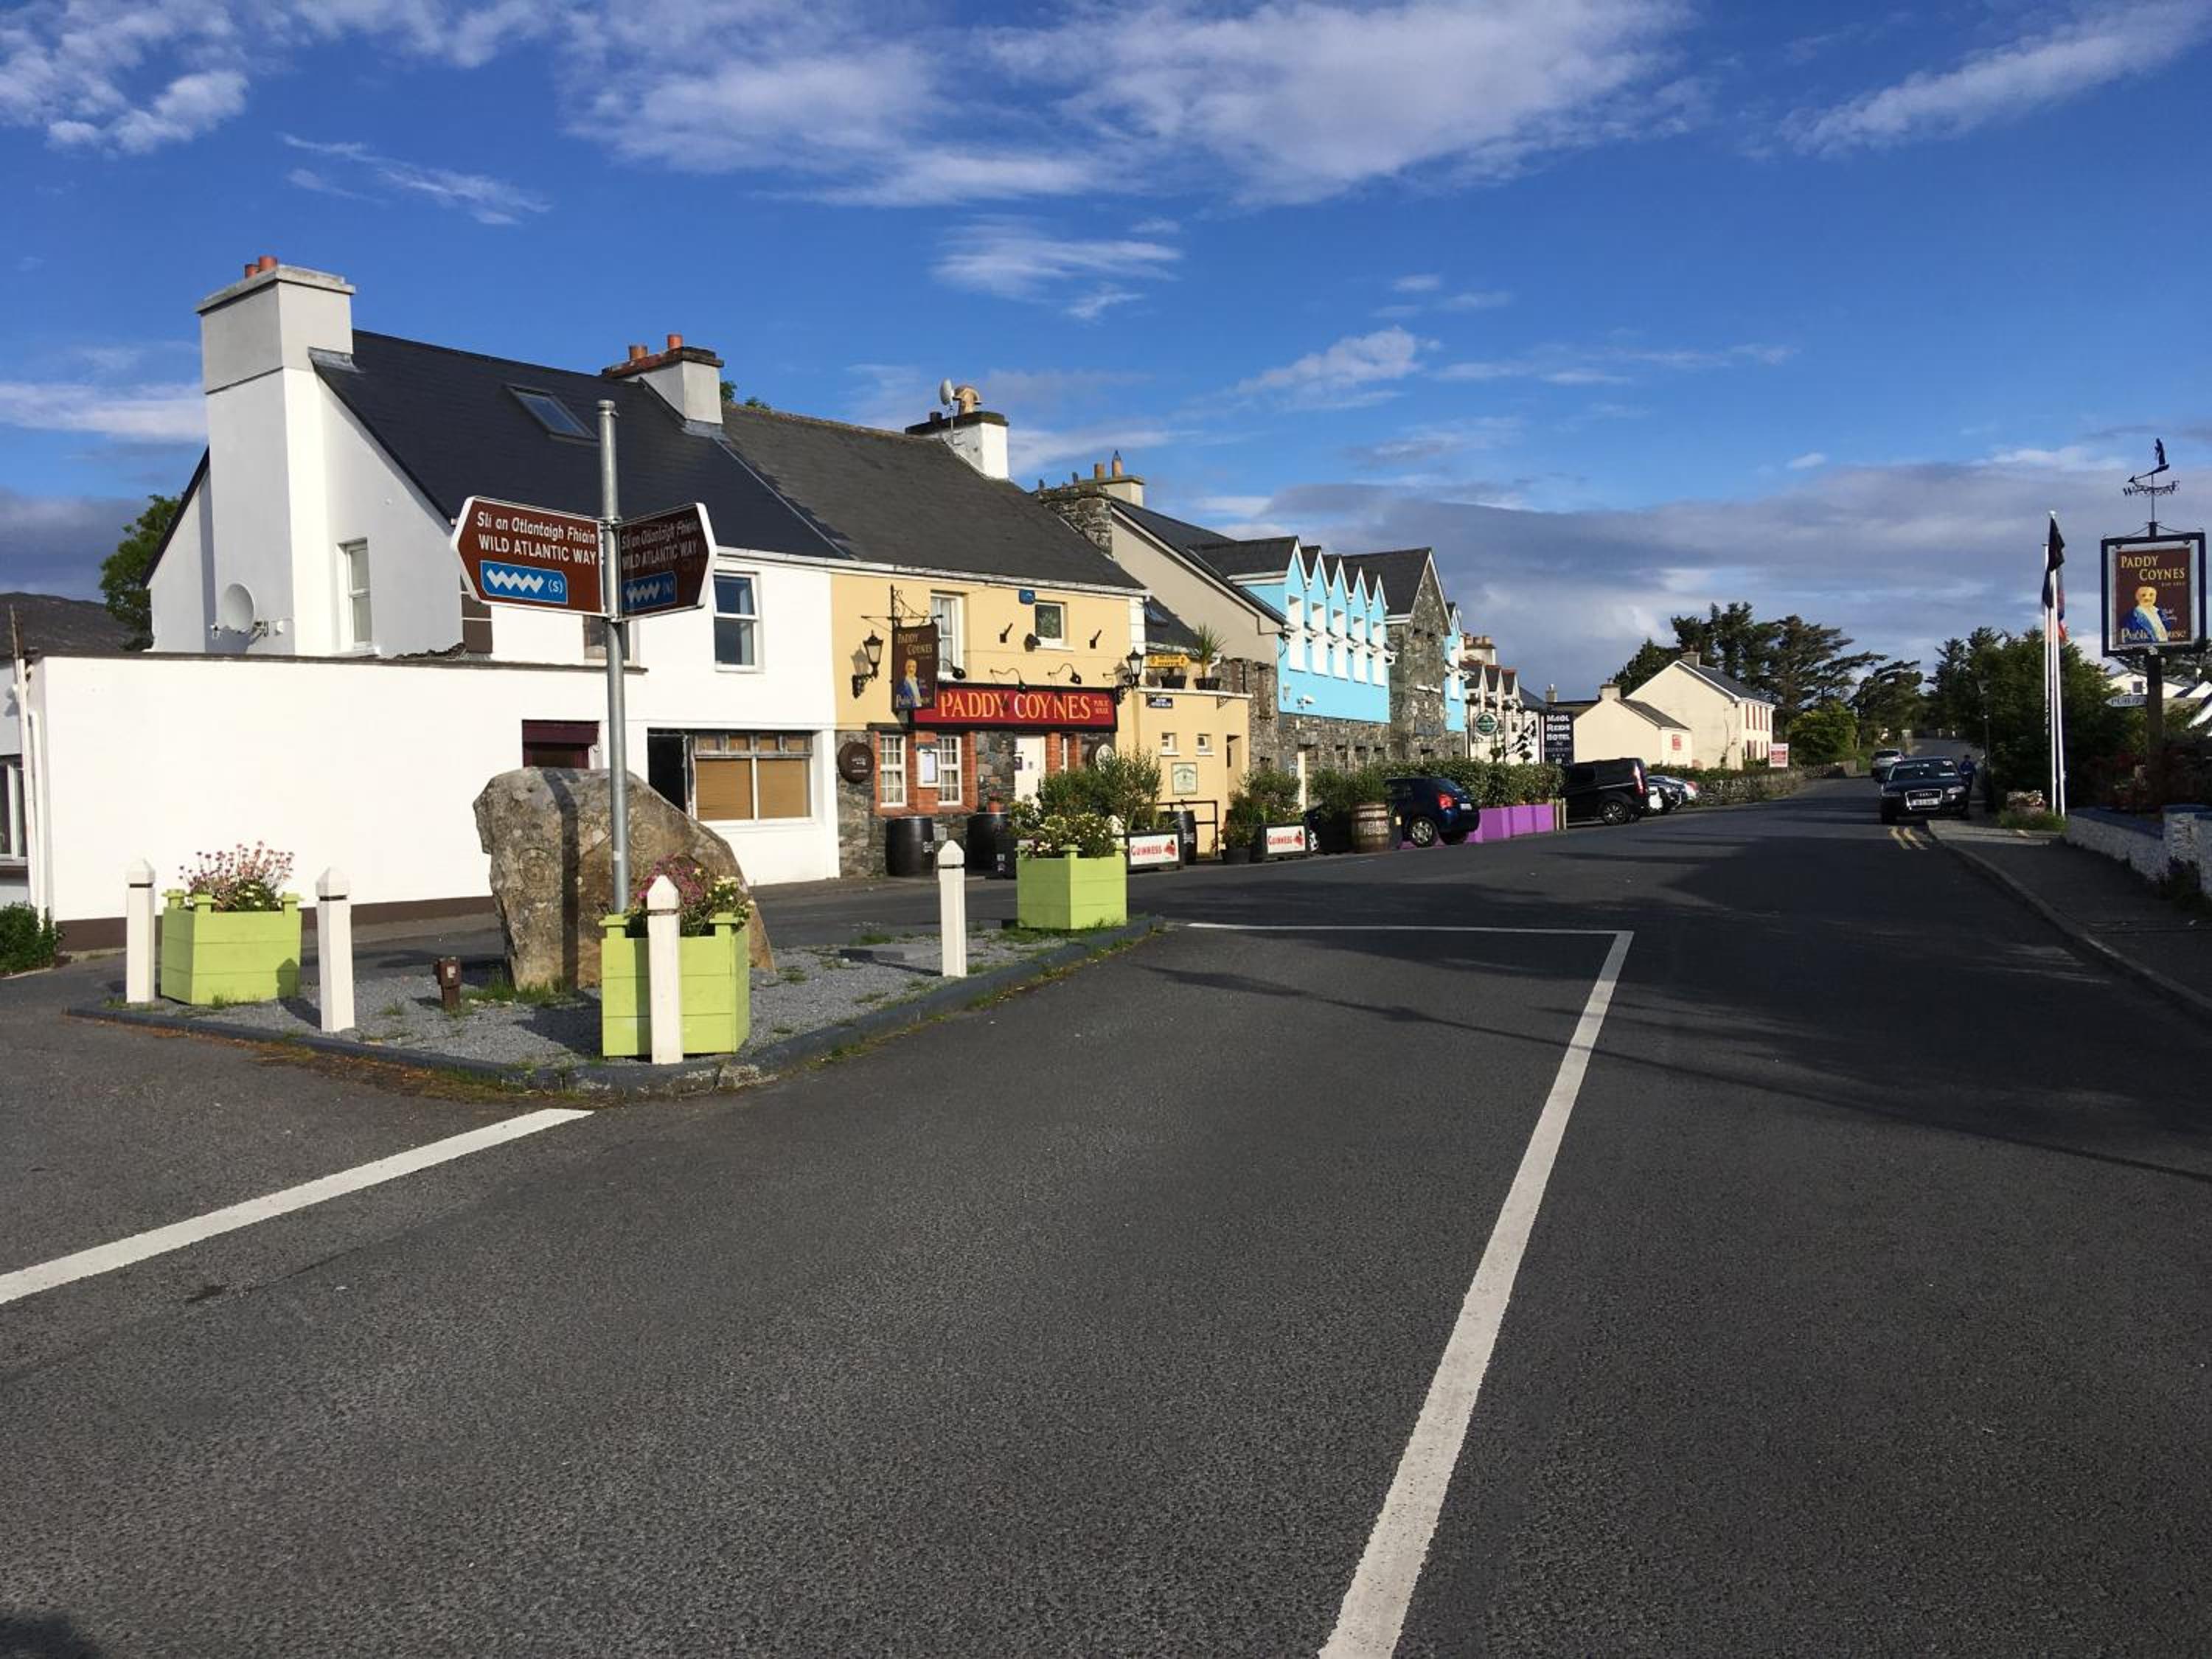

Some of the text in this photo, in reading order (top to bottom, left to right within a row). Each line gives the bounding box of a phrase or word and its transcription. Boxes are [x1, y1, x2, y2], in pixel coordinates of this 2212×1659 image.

[495, 518, 508, 531] an
[479, 533, 597, 566] WILD ATLANTIC WAY
[641, 544, 678, 567] ATLANTIC
[680, 538, 697, 557] WAY
[2121, 555, 2159, 568] PADDY
[2139, 567, 2185, 582] COYNES
[548, 578, 563, 594] (S)
[940, 692, 1009, 717] PADDY
[1014, 693, 1091, 720] COYNES
